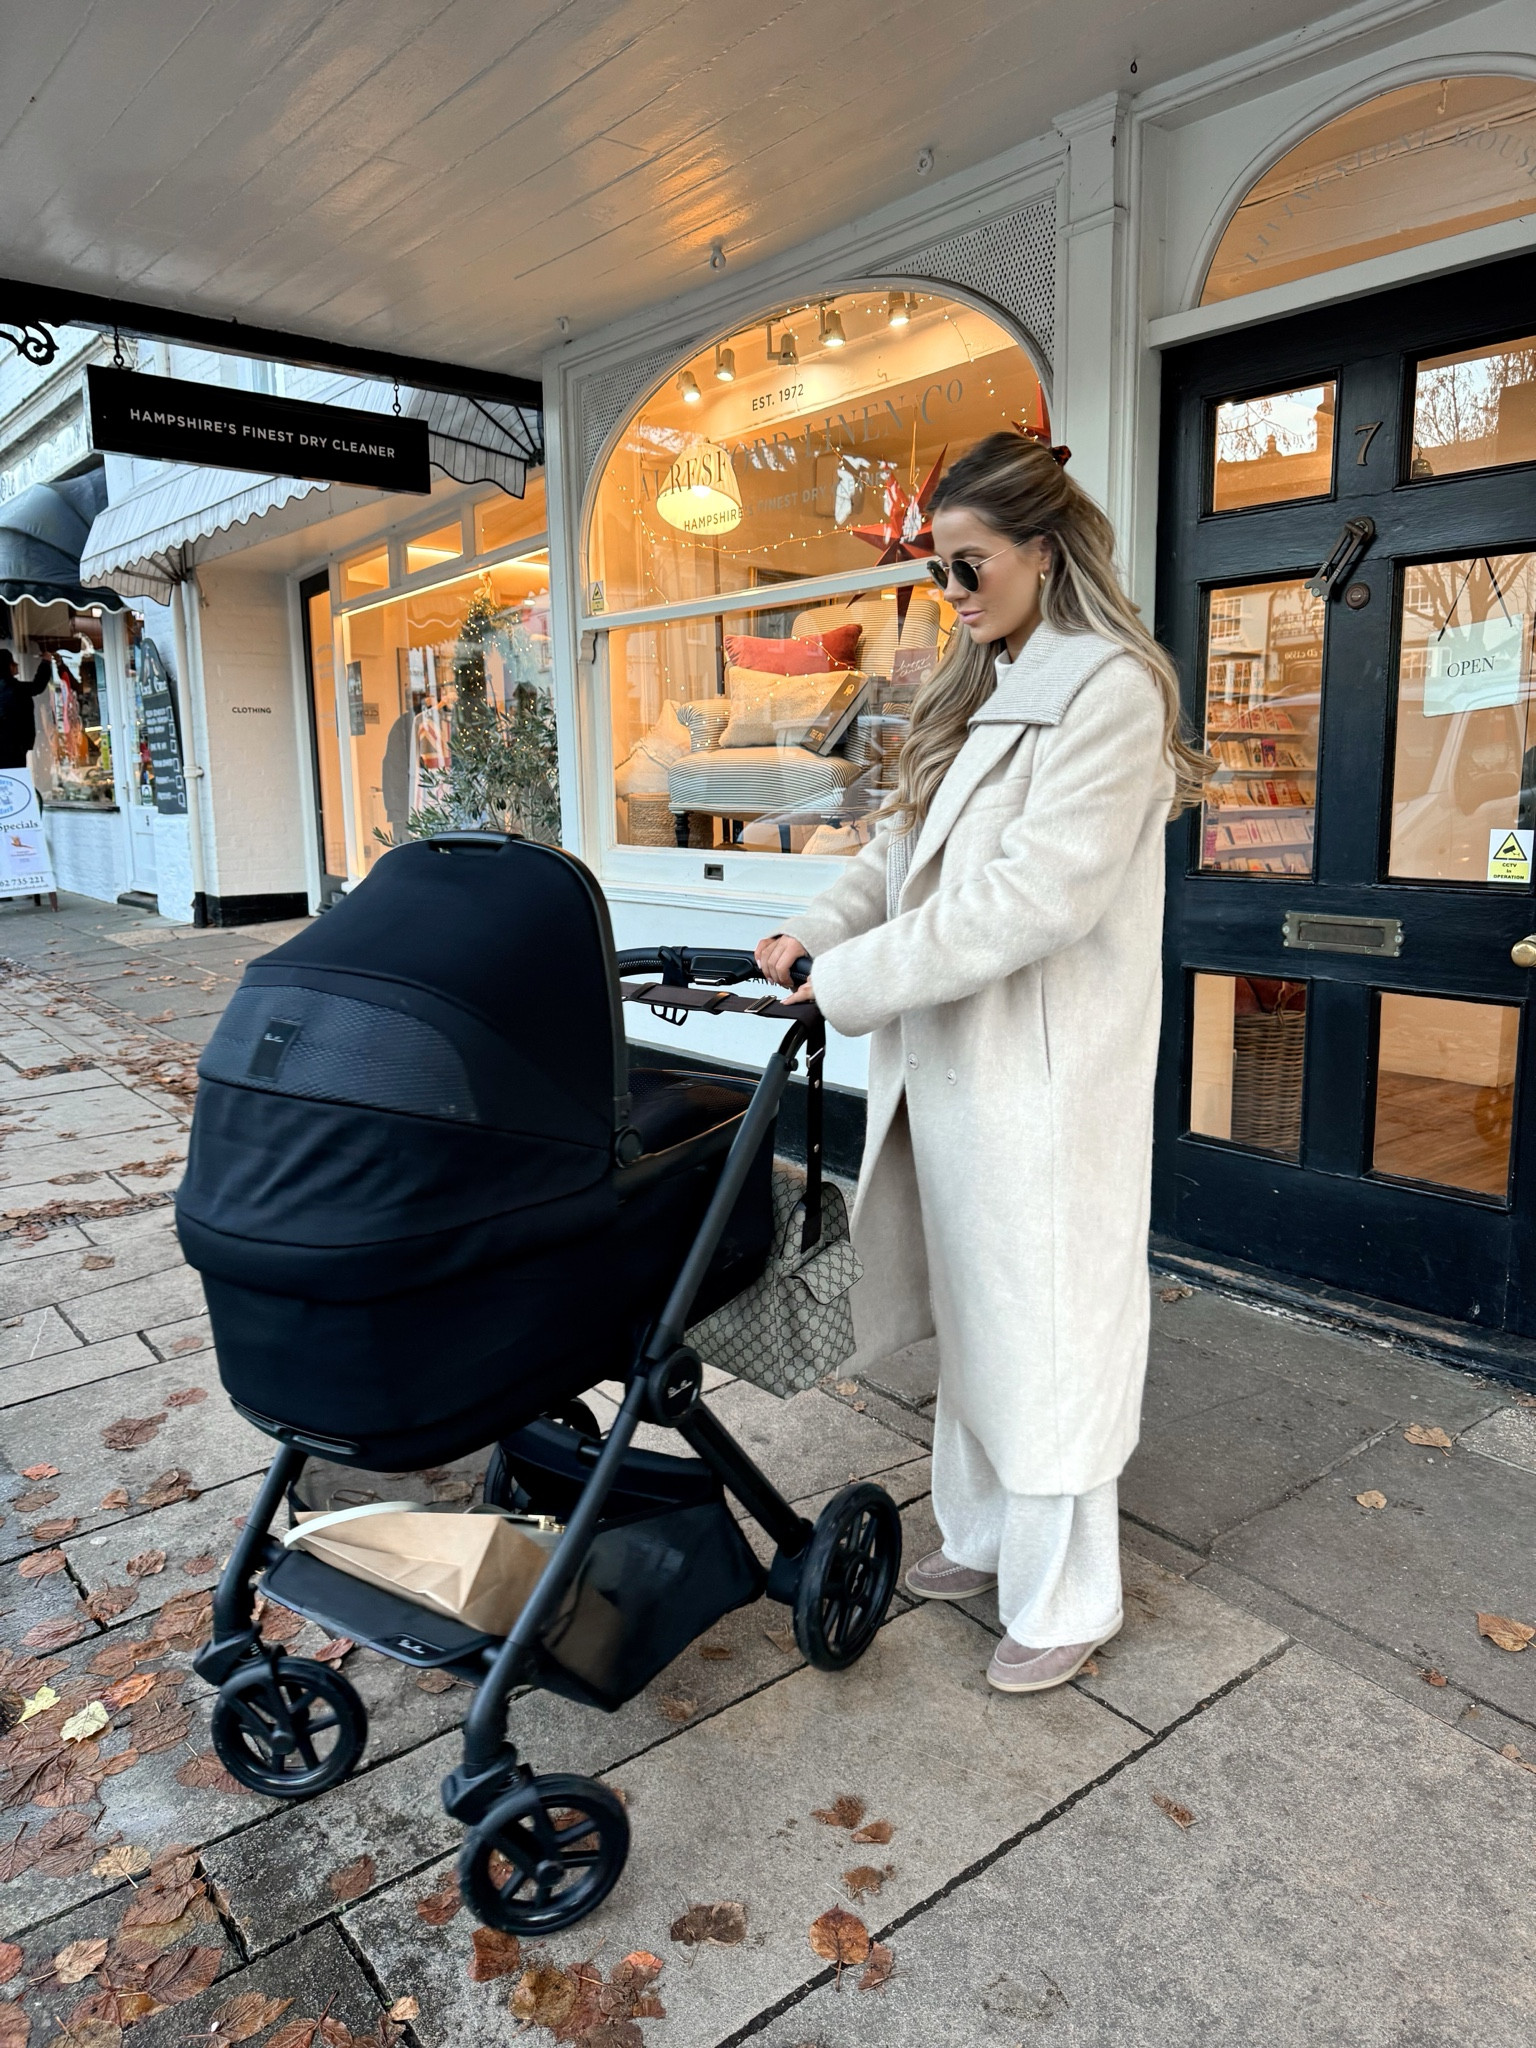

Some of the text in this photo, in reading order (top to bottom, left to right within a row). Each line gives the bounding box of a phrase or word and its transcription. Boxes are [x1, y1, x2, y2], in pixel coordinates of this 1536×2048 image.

[752, 383, 805, 412] EST. 1972
[129, 407, 396, 459] HAMPSHIRE'S FINEST DRY CLEANER
[803, 394, 906, 458] LINEN
[1354, 421, 1382, 466] 7
[802, 485, 827, 503] DRY
[1446, 655, 1496, 678] OPEN
[231, 706, 272, 714] CLOTHING
